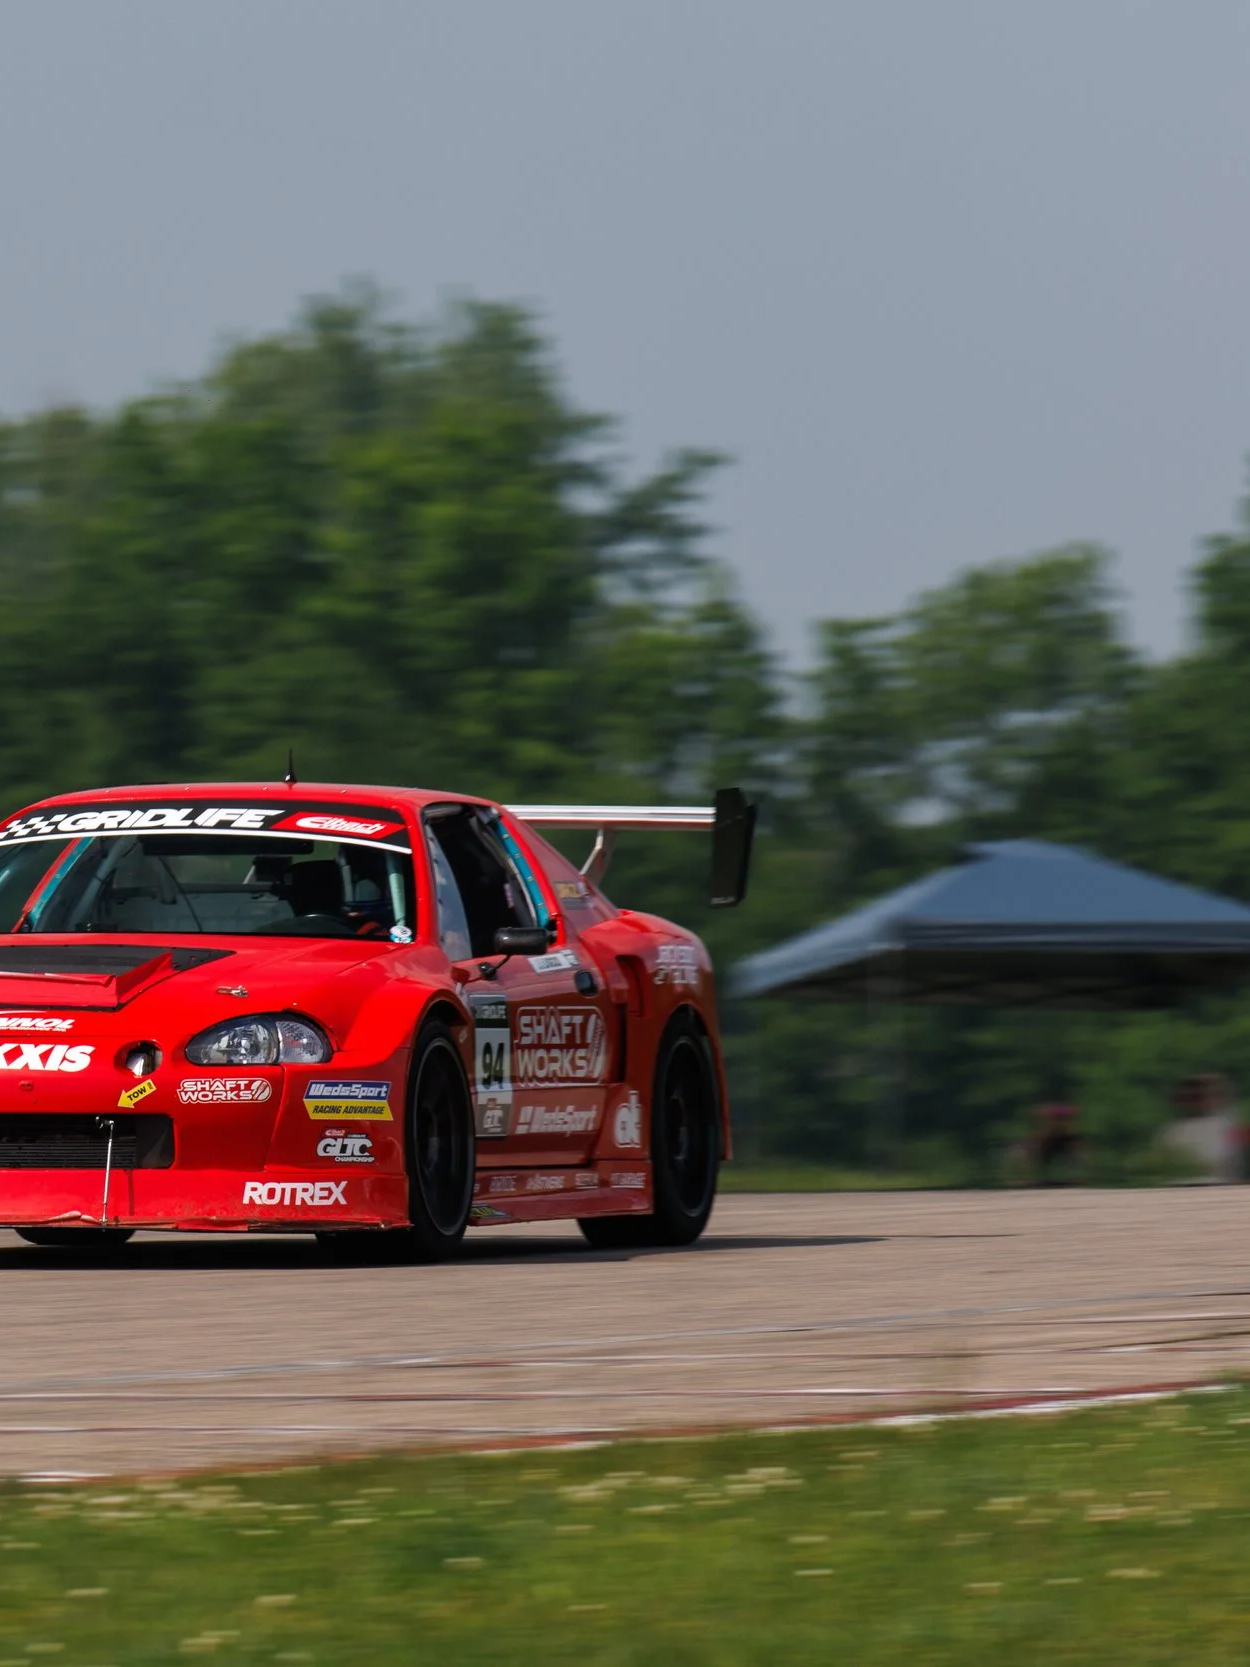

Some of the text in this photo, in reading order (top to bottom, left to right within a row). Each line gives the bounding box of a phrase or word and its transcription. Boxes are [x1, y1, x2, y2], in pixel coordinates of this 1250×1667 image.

[55, 808, 285, 831] GRIDLIFE
[518, 1015, 584, 1045] SHAFT
[482, 1041, 505, 1090] 94
[516, 1048, 588, 1078] WORKS
[127, 1085, 147, 1101] TOW
[183, 1080, 249, 1091] SHAFT
[308, 1083, 387, 1099] WedsSport
[180, 1090, 253, 1102] WORKS
[312, 1105, 386, 1116] RACING ADVANTAGE
[317, 1138, 373, 1157] GLTC
[242, 1181, 348, 1206] ROTREX
